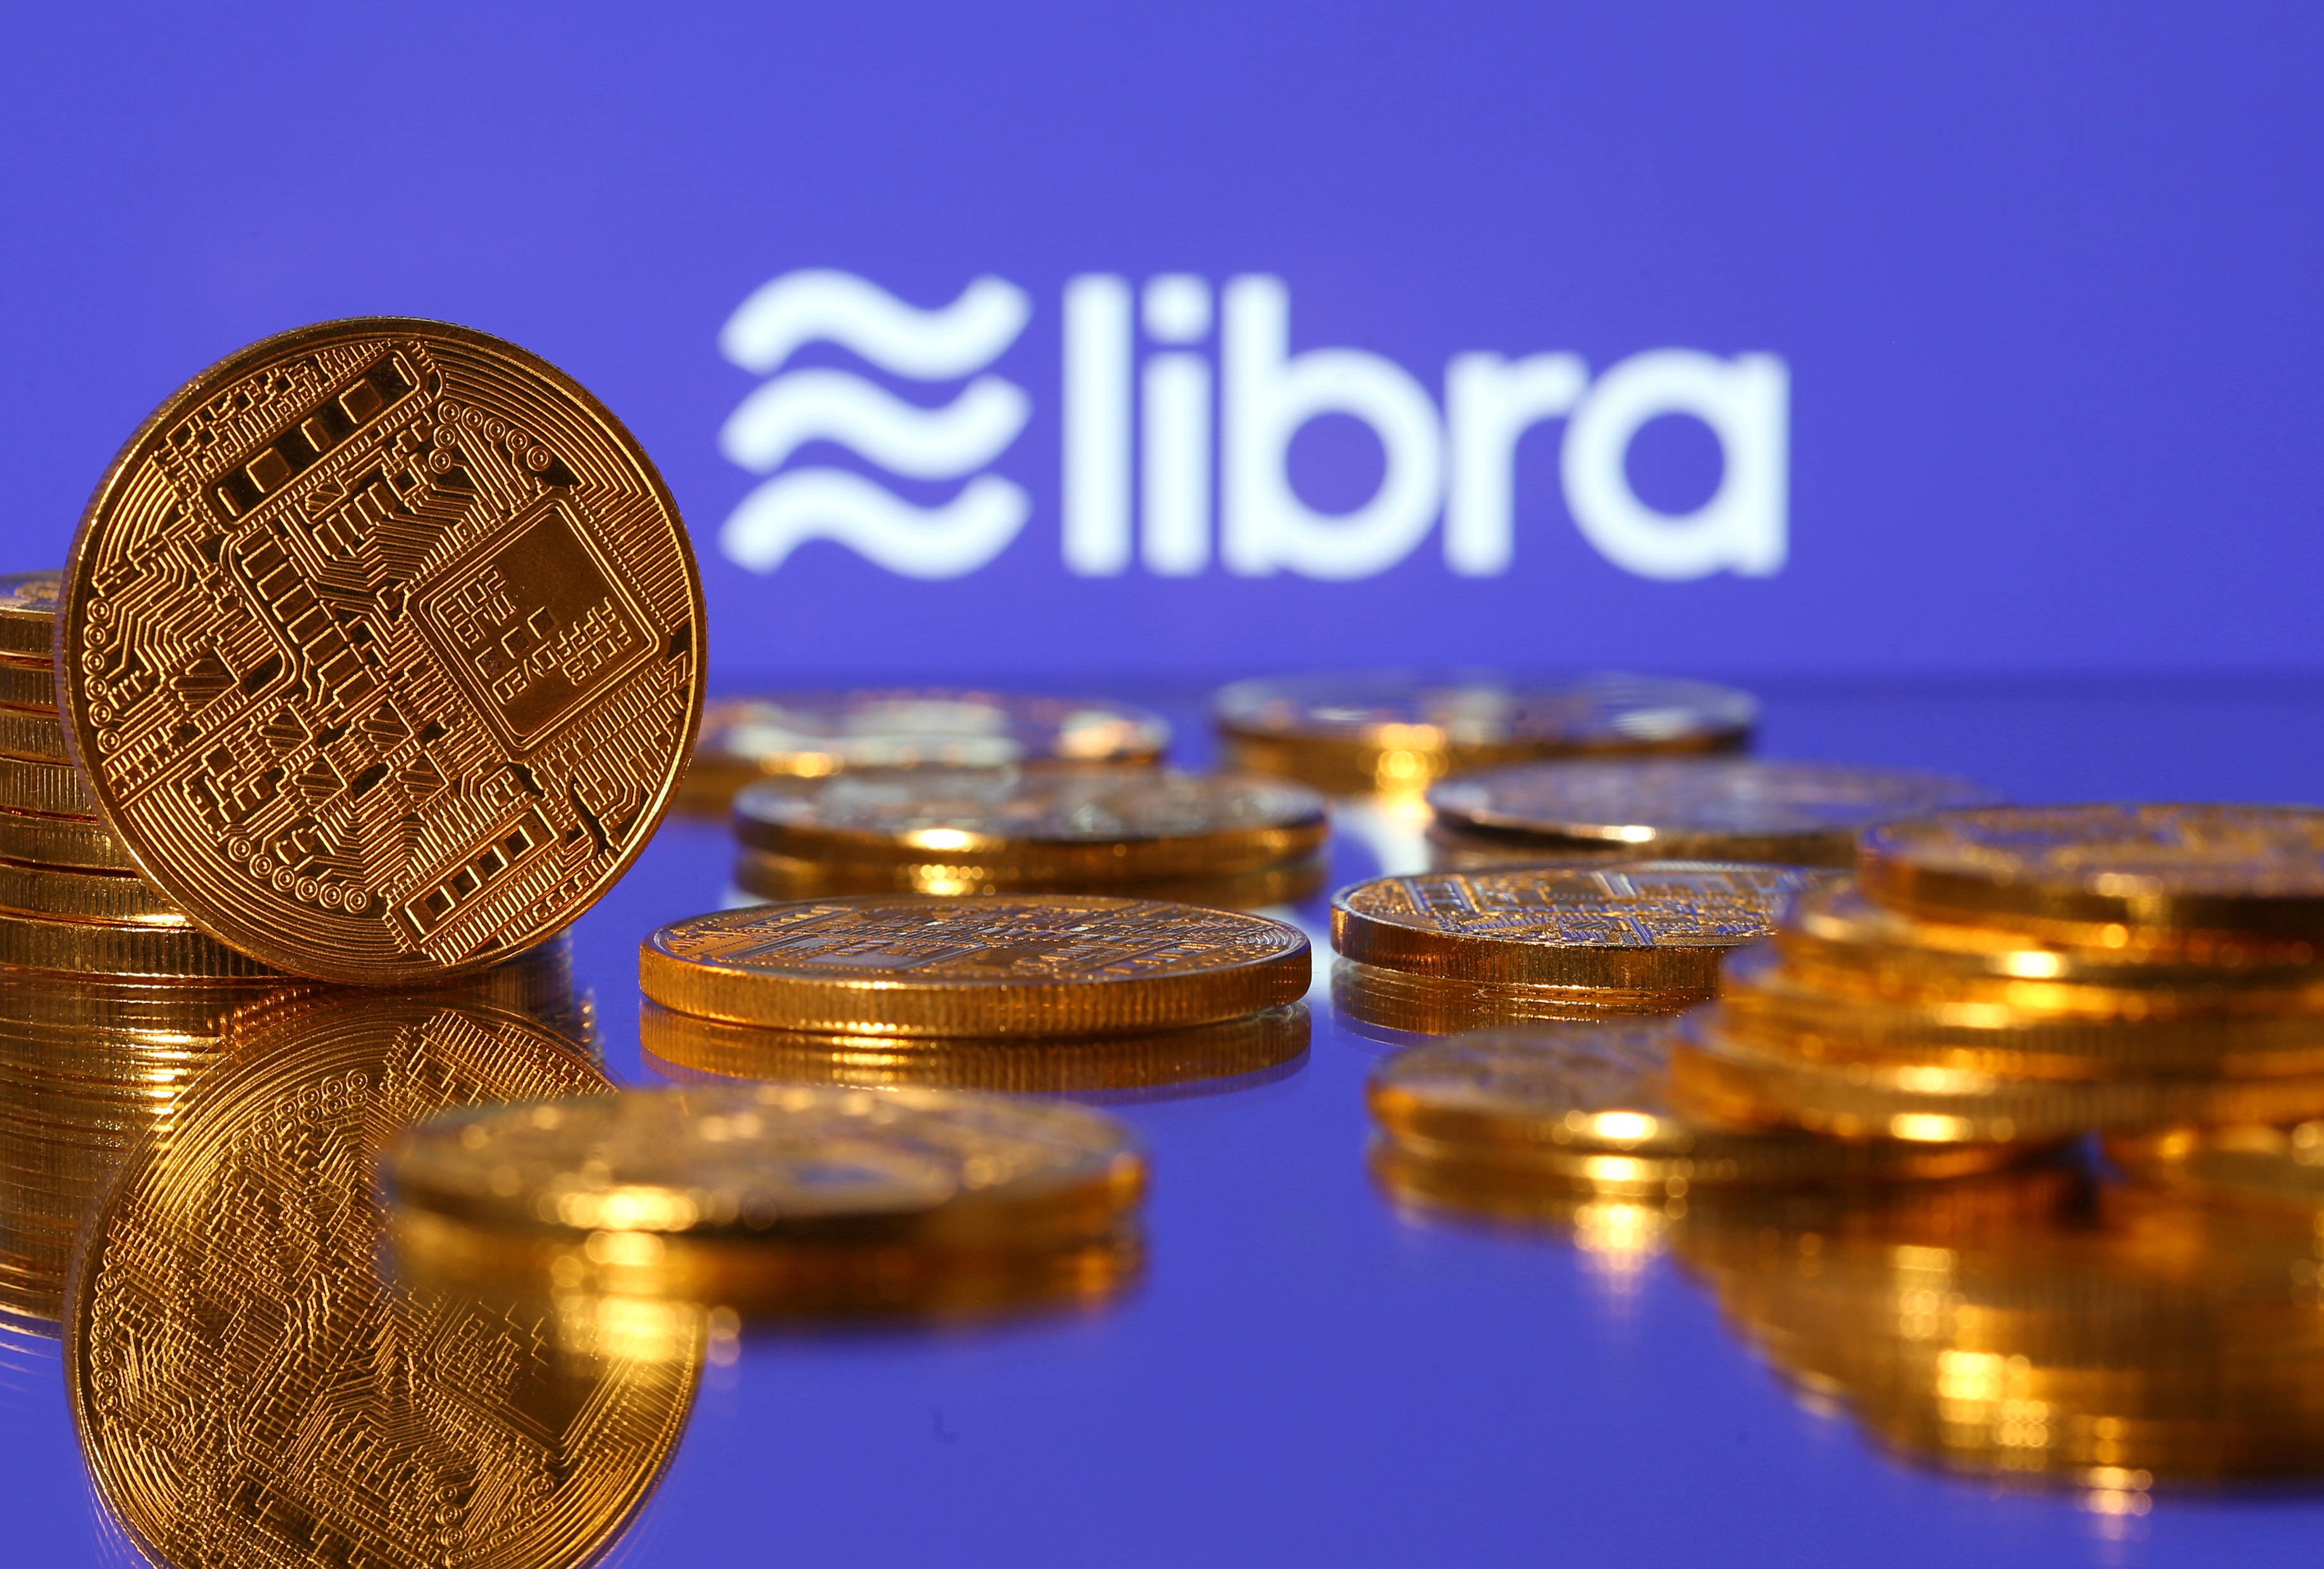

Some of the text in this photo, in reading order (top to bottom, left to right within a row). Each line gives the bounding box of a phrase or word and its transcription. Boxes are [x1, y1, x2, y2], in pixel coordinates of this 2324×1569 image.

[1060, 273, 1790, 581] libra
[437, 564, 507, 629] 2013
[492, 596, 618, 705] APPROVED
